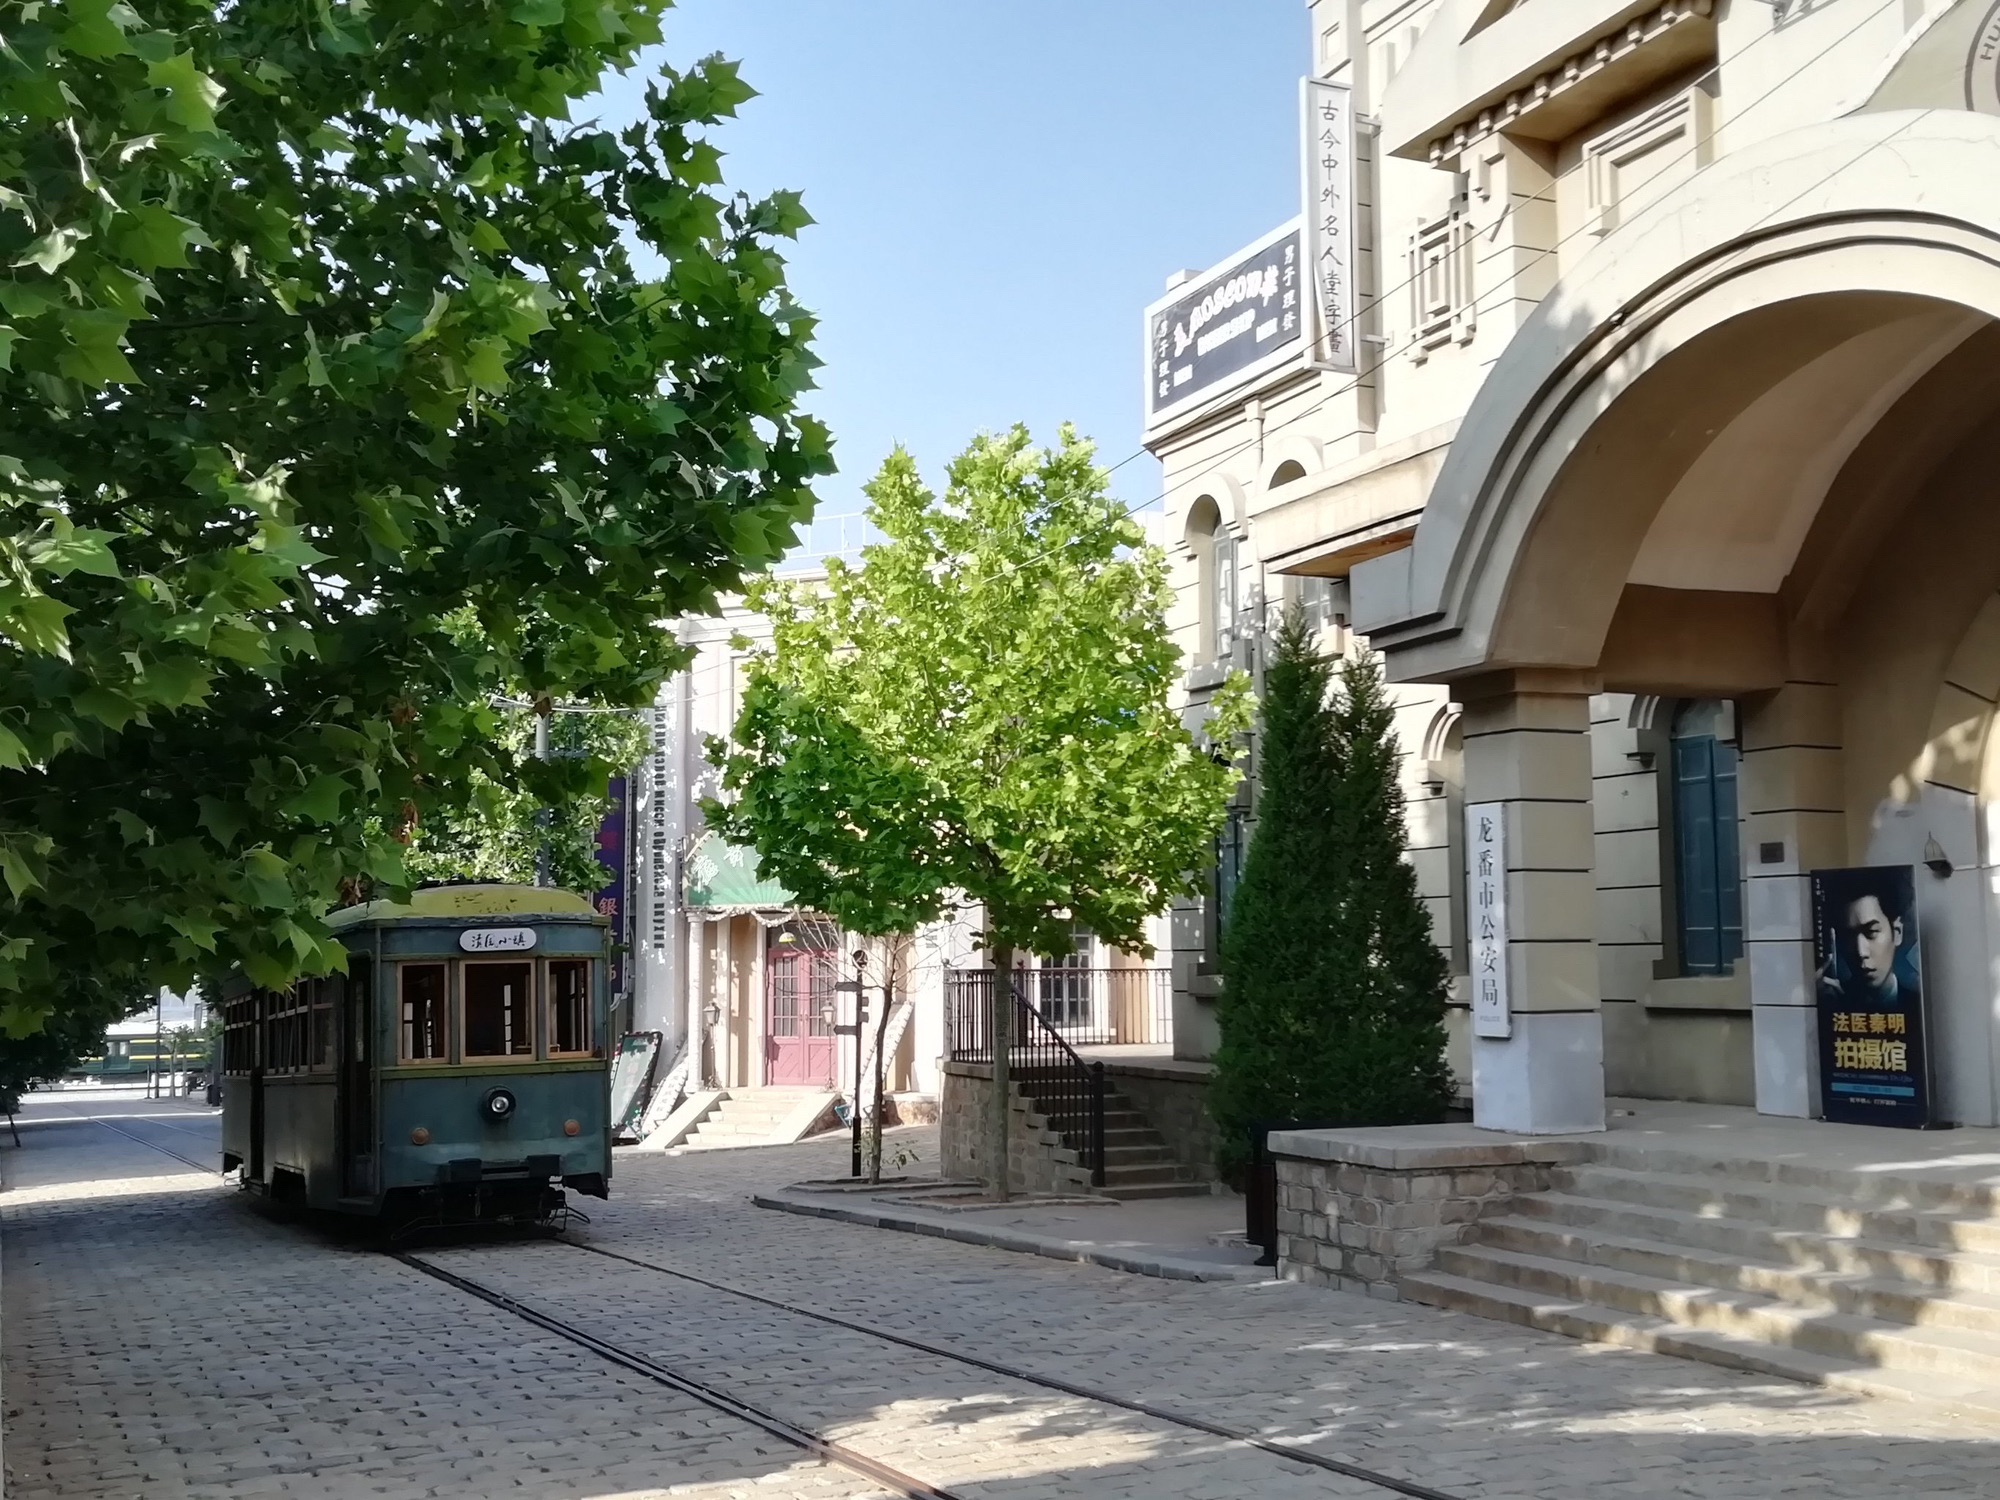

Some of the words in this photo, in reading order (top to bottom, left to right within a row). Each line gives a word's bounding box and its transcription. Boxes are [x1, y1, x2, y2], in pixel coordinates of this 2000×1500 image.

[1478, 816, 1499, 1006] 龙番市公安局
[1832, 1012, 1906, 1034] 法医秦明
[1834, 1037, 1907, 1072] 拍摄馆
